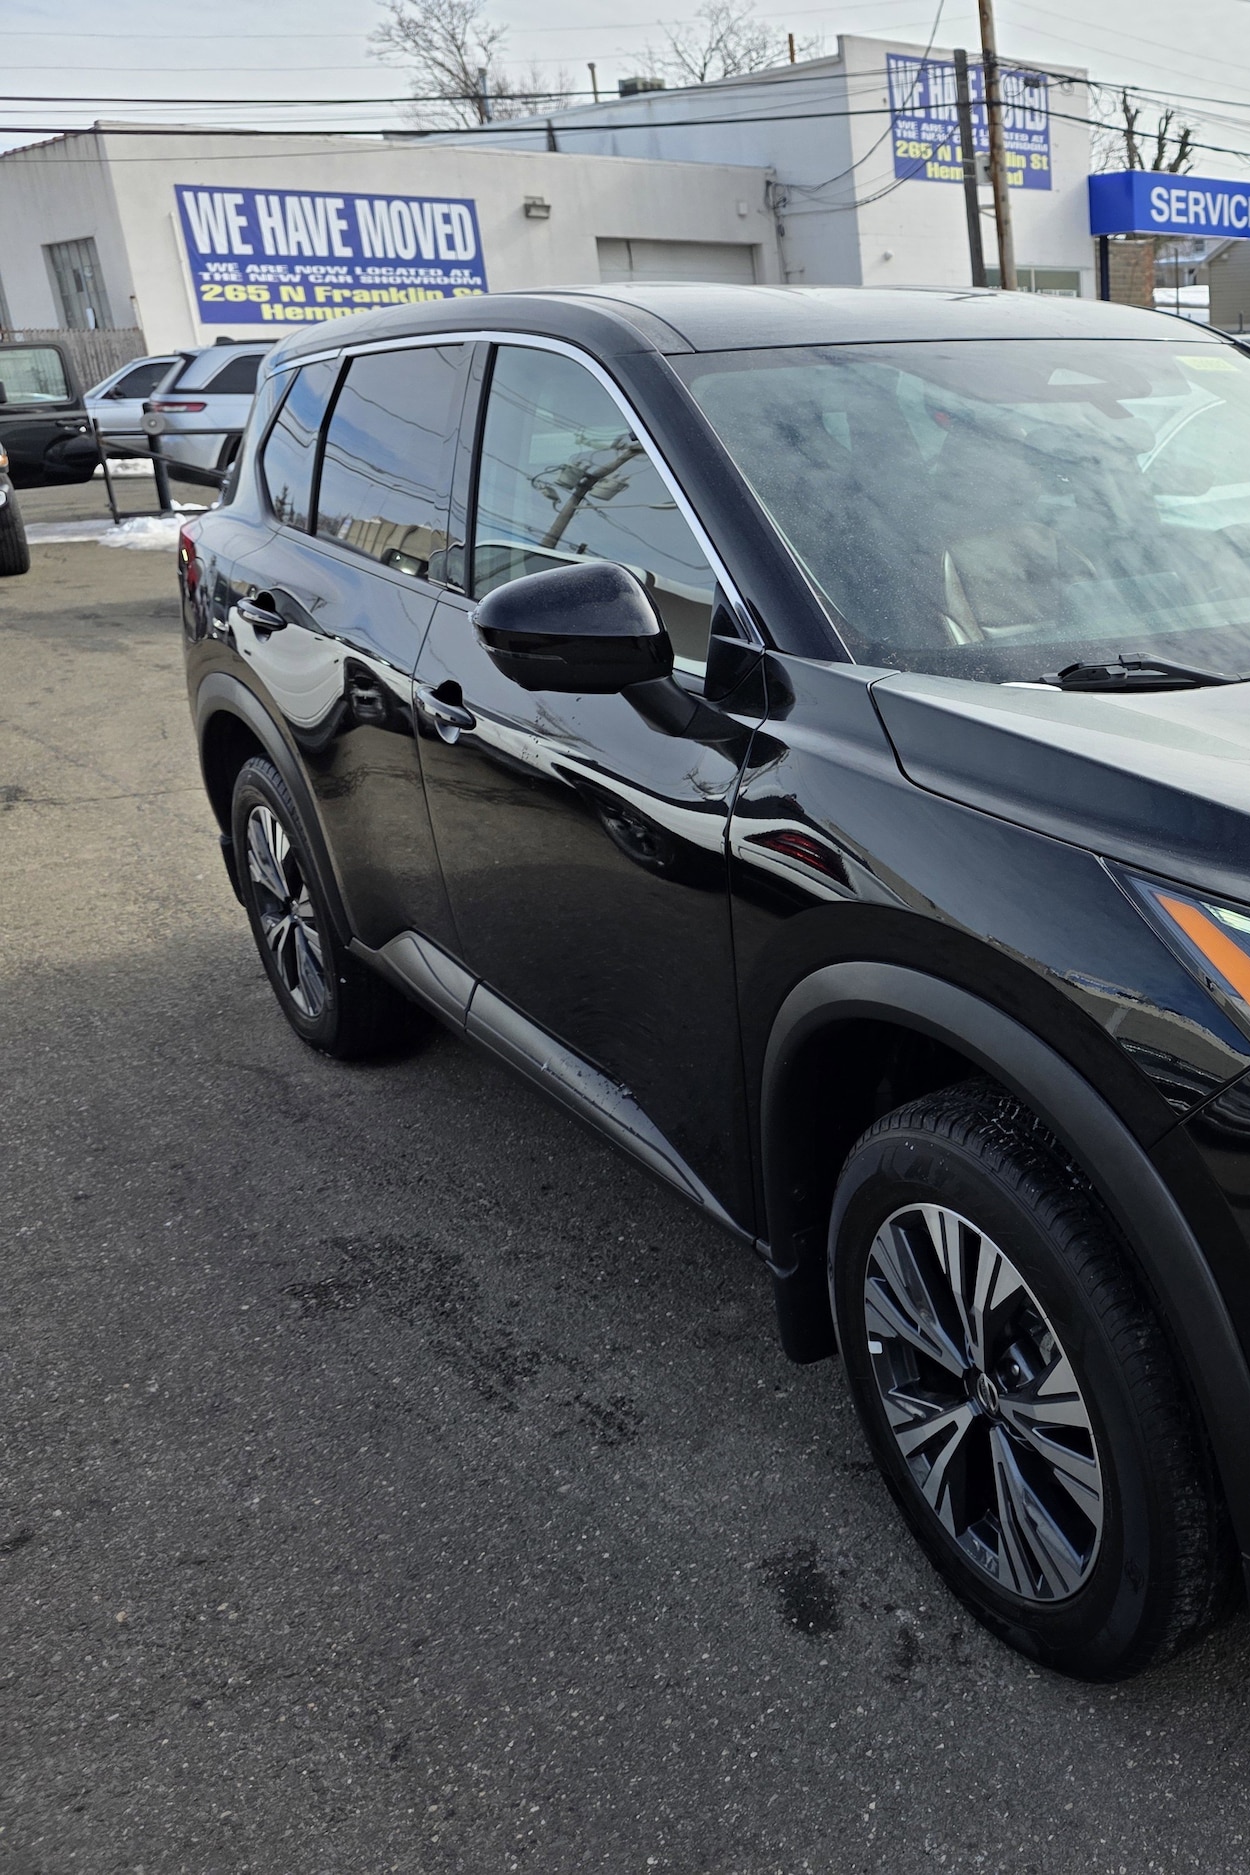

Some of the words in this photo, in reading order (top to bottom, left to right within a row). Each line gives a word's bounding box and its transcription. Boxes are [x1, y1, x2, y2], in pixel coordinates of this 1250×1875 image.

[889, 58, 926, 118] WE
[928, 64, 979, 124] HAE
[896, 120, 918, 131] WE
[921, 122, 945, 133] ARE
[979, 128, 1030, 142] LATED
[1031, 134, 1045, 144] AT
[895, 129, 919, 140] THE
[921, 131, 949, 143] NEW
[979, 136, 1049, 152] SWROOM
[895, 140, 934, 160] 265
[937, 144, 952, 162] N
[1030, 153, 1049, 171] St
[182, 191, 254, 255] WE
[255, 194, 354, 258] HAVE
[354, 198, 477, 261] MOVED
[198, 272, 243, 282] THE
[250, 273, 301, 283] NEW
[308, 274, 353, 284] CAR
[359, 275, 482, 285] SHOWROOM
[206, 262, 238, 273] WE
[246, 263, 288, 274] ARE
[294, 265, 348, 275] NOW
[354, 266, 443, 277] LOCATED
[449, 268, 473, 277] AT
[200, 284, 271, 302] 265
[279, 286, 306, 302] N
[314, 286, 444, 304] Franklin
